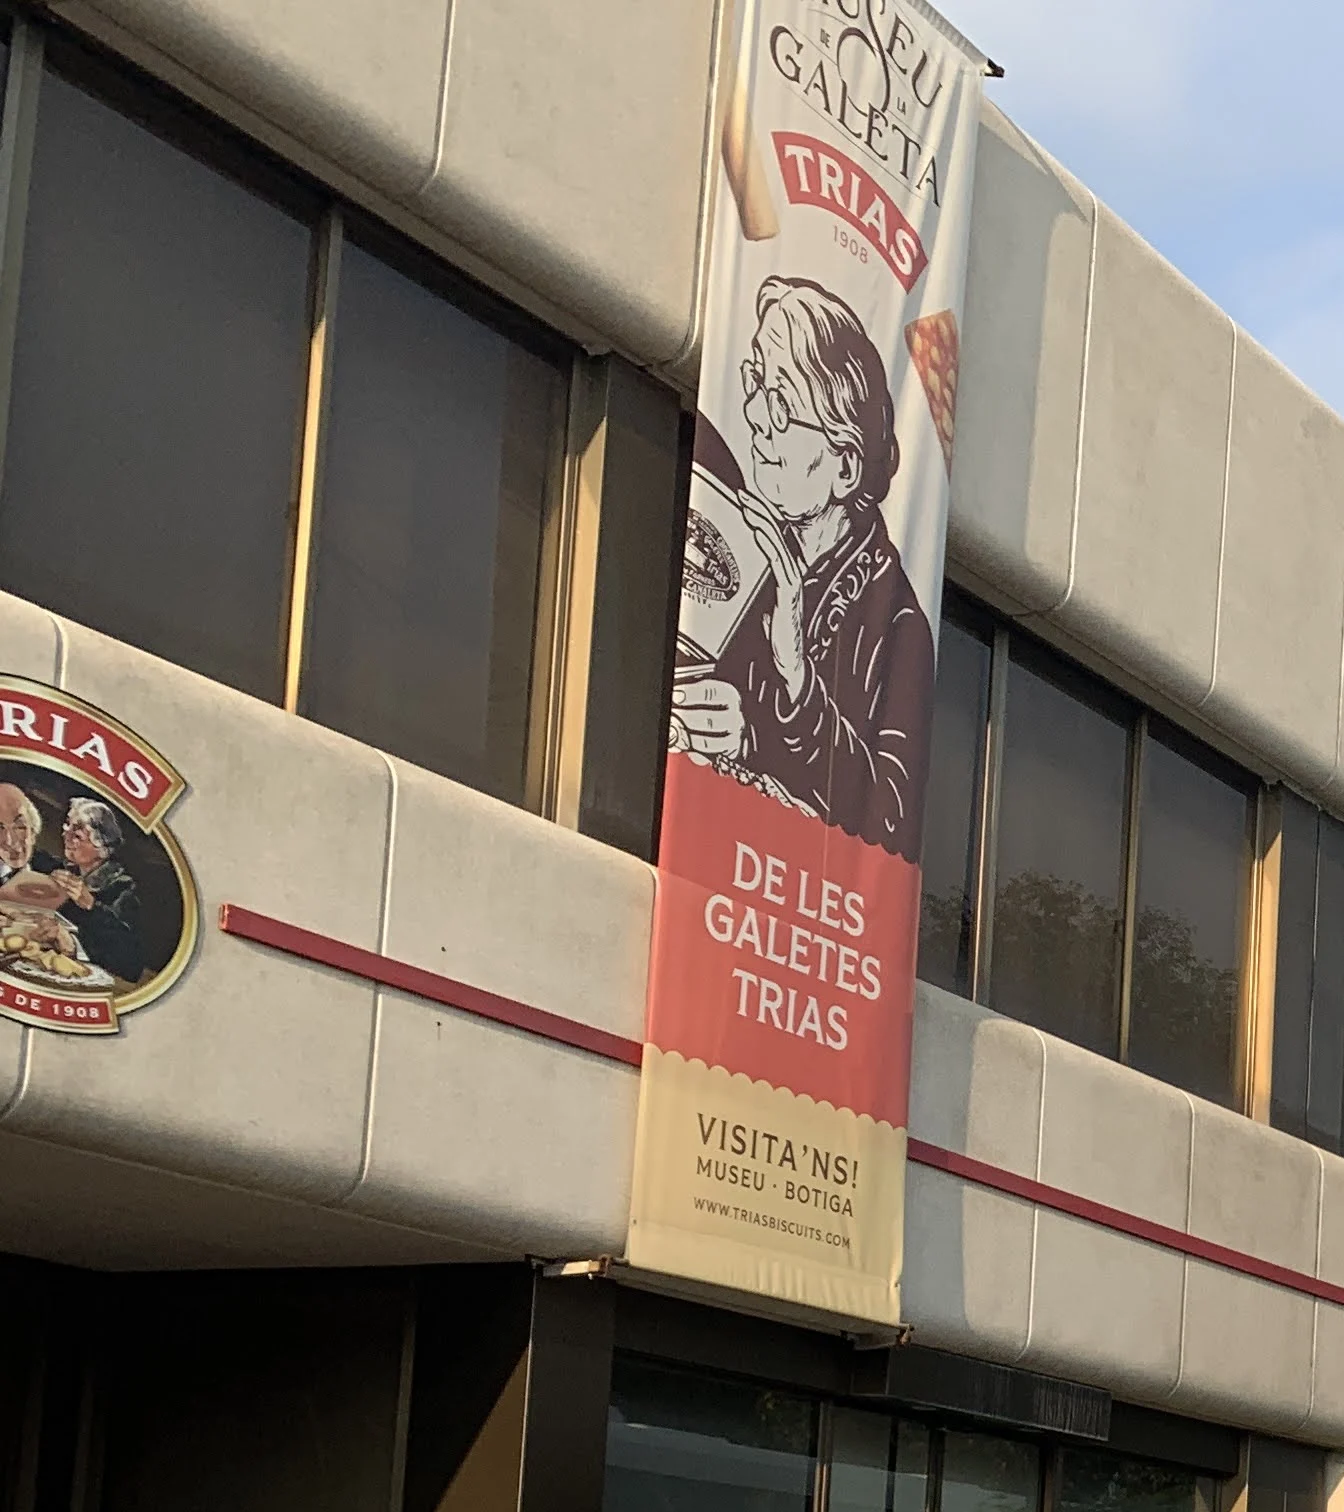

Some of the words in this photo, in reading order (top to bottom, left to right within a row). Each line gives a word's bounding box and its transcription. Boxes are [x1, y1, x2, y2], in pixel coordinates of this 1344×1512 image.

[769, 25, 940, 208] GALETA
[897, 97, 906, 115] LA
[785, 144, 919, 276] TRIAS
[832, 225, 868, 264] 1908
[0, 701, 153, 799] RIAS
[732, 840, 787, 905] DE
[796, 869, 865, 936] LES
[704, 893, 881, 1000] GALETES
[15, 994, 41, 1011] DE
[52, 1003, 99, 1018] 1908
[732, 967, 848, 1050] TRIAS
[693, 1196, 851, 1249] WWW.TRIASBISCUITS.COM
[696, 1155, 766, 1192] MUSEU
[784, 1180, 854, 1217] BOTIGA
